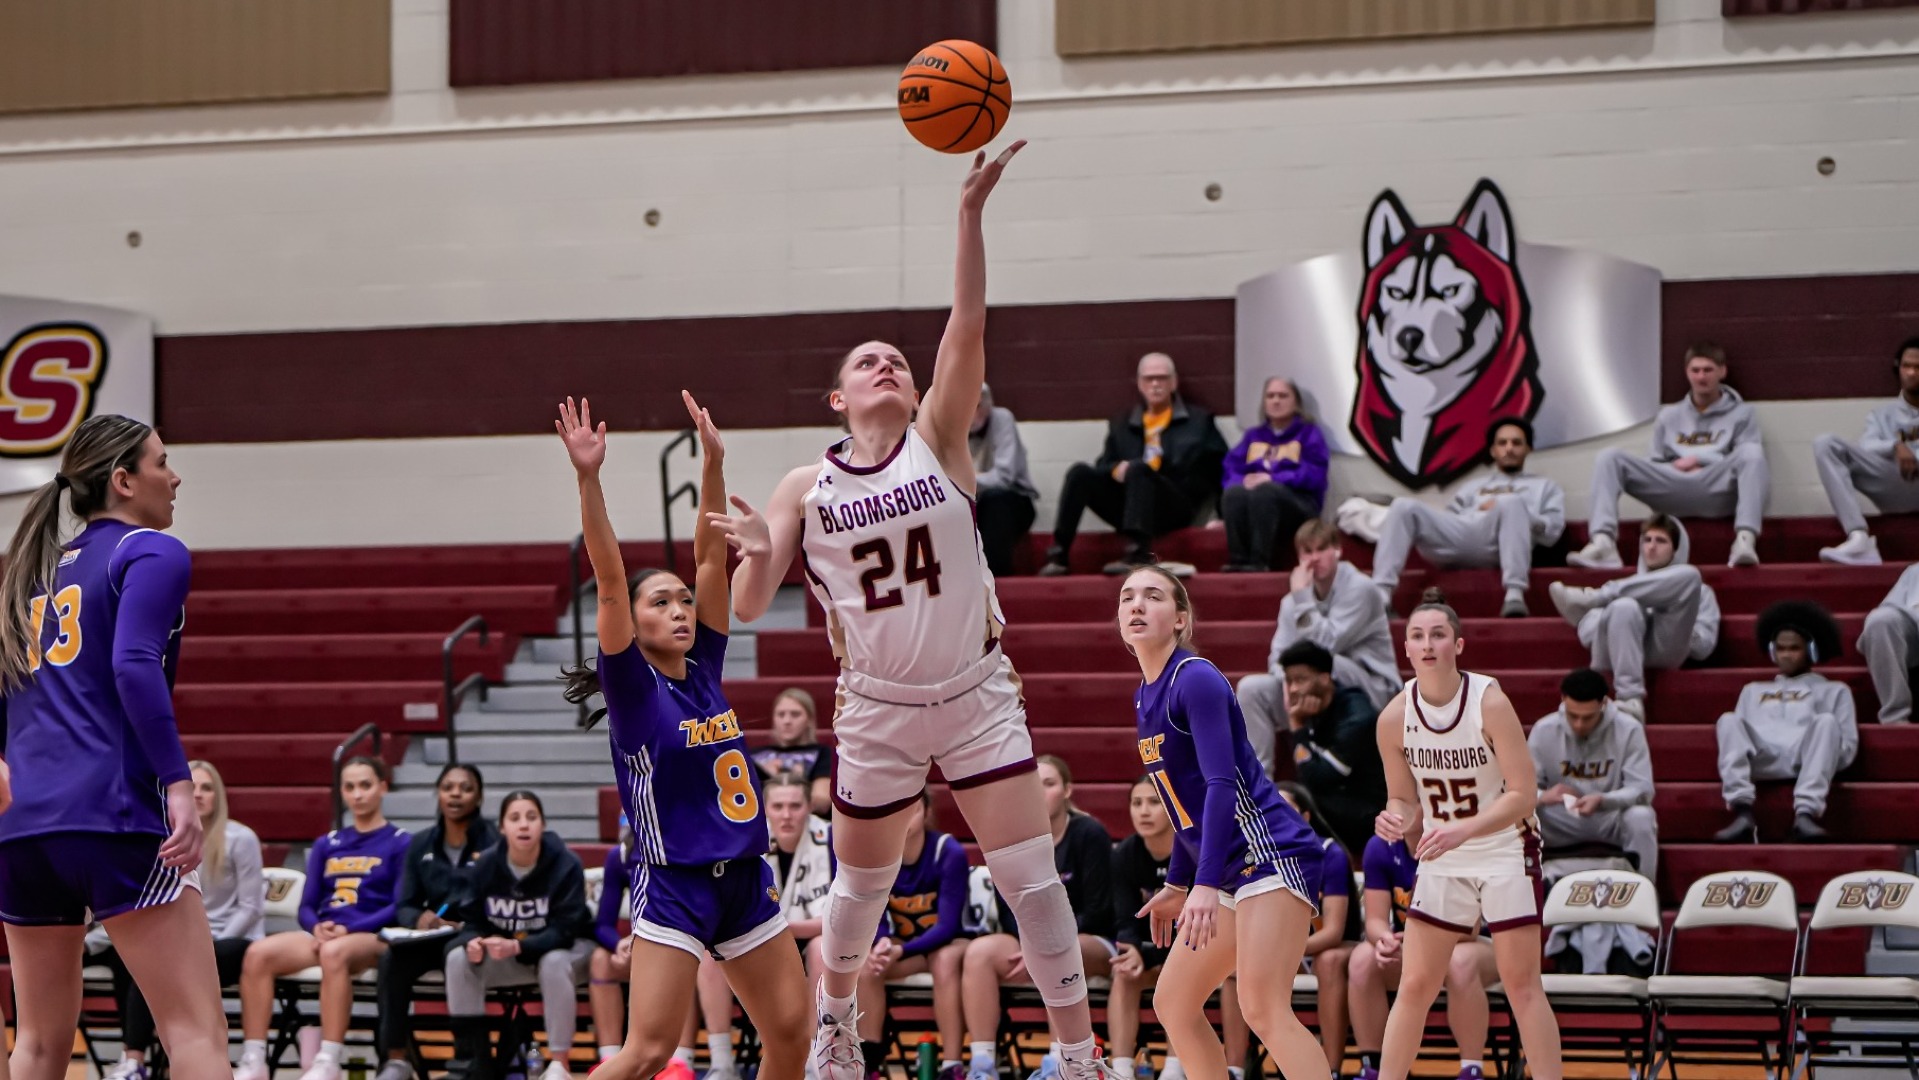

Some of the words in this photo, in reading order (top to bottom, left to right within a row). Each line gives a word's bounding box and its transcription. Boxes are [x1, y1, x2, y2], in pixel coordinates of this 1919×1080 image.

[817, 475, 946, 534] BLOOMSBURG
[851, 523, 941, 614] 24
[26, 584, 83, 673] 13
[1138, 733, 1166, 765] CU
[1404, 746, 1488, 770] BLOOMSBURG
[1560, 758, 1615, 780] WCU
[713, 749, 759, 823] 8
[1148, 769, 1193, 832] 1
[1422, 777, 1479, 822] 25
[329, 877, 362, 909] 5
[487, 896, 549, 918] WCU
